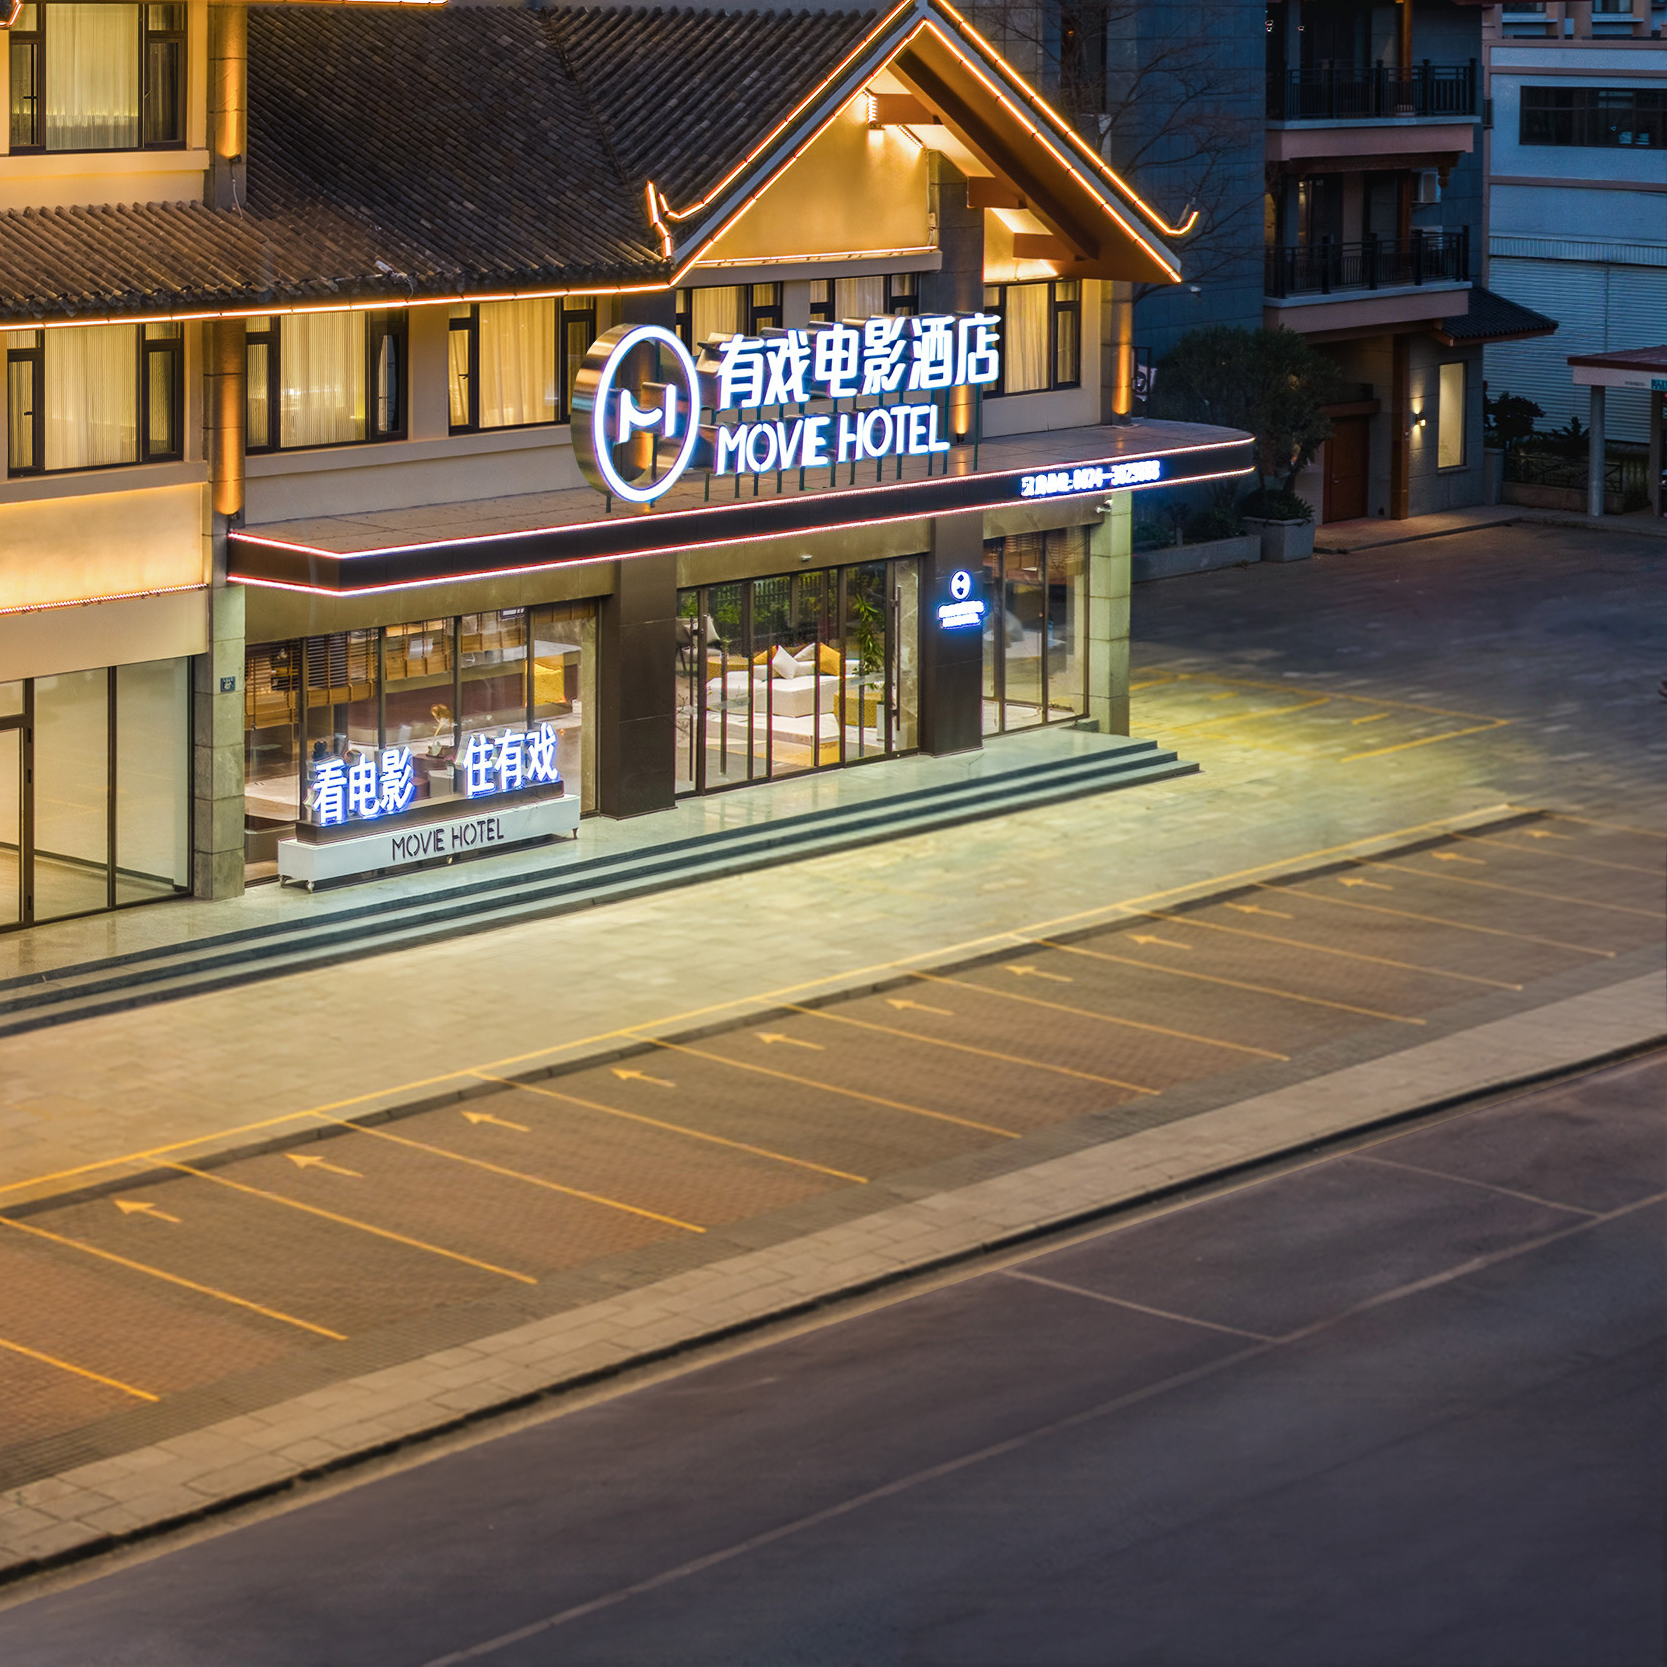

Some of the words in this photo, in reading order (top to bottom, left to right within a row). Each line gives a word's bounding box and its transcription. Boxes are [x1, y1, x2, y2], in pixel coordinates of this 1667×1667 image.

[718, 313, 1001, 409] 有戏电影酒店
[836, 403, 951, 464] HOTEL
[312, 746, 415, 827] 看电影
[462, 722, 561, 799] 住有戏
[392, 828, 445, 860] MOVIE
[452, 819, 504, 848] HOTEL
